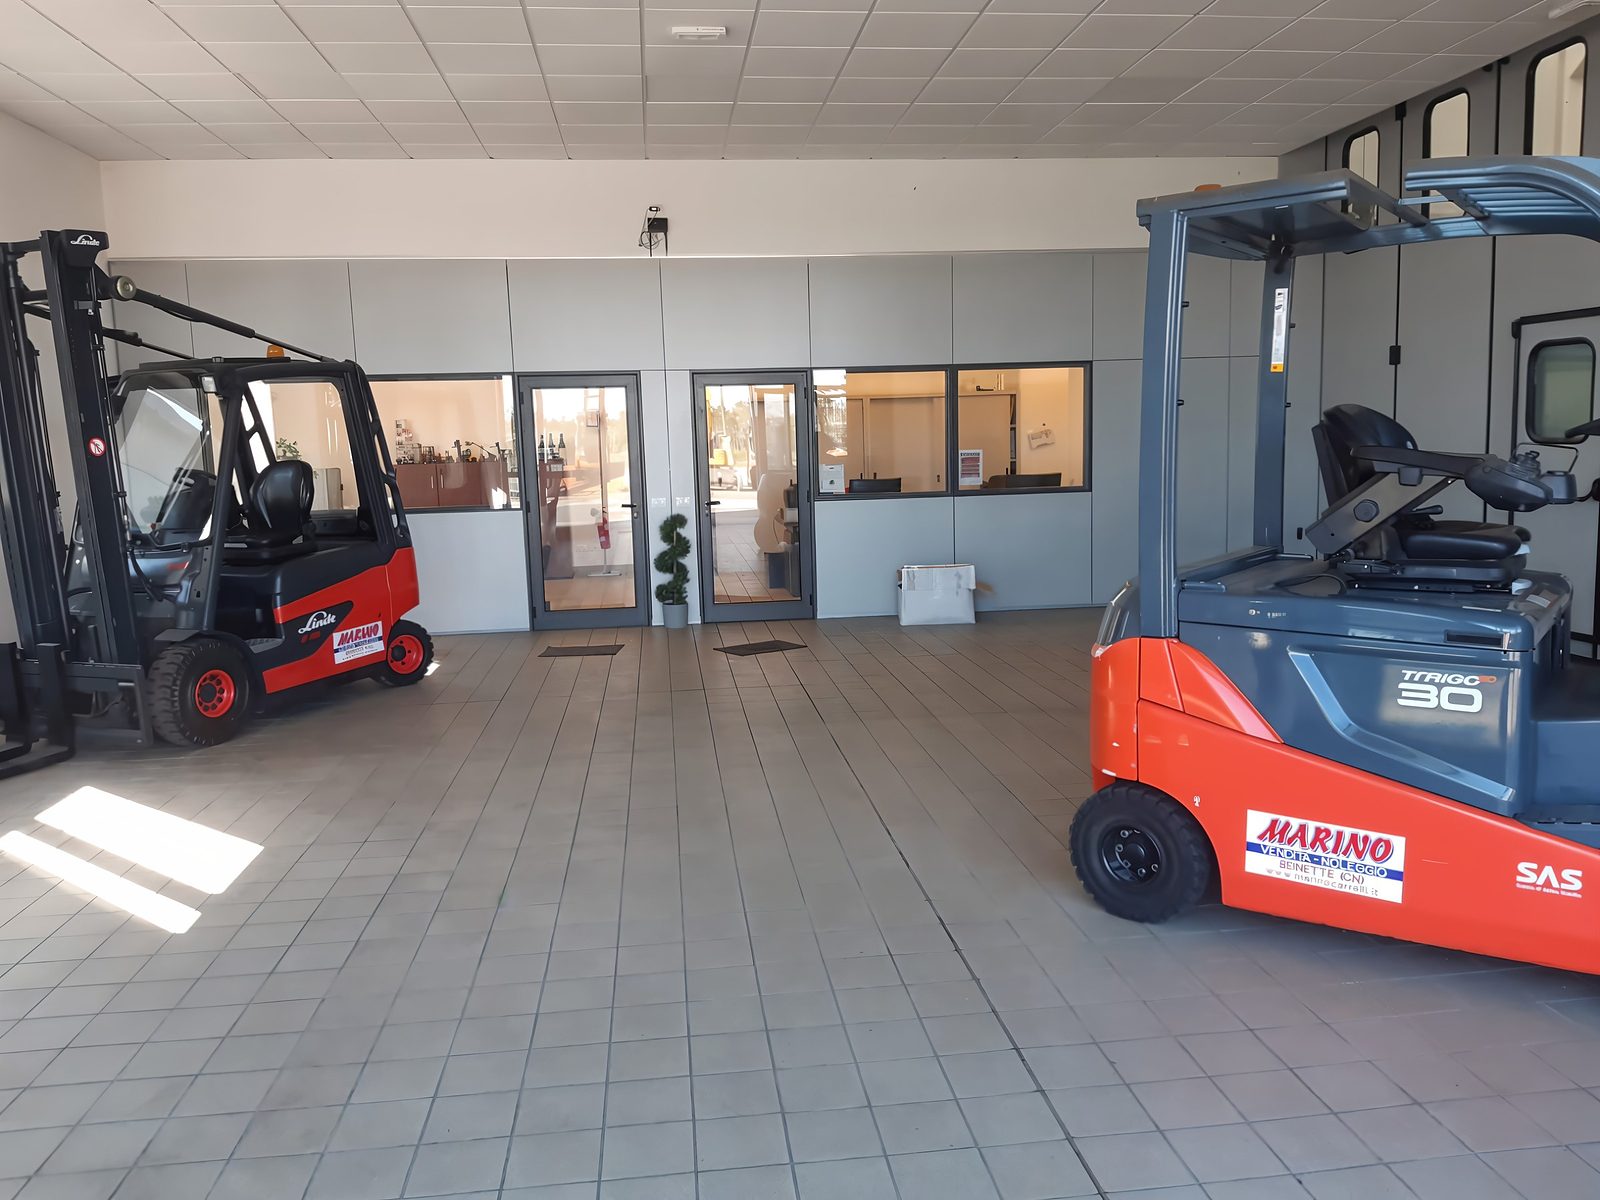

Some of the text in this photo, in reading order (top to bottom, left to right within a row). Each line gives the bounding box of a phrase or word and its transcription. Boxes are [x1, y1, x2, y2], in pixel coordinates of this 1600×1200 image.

[298, 611, 336, 634] Linde
[1397, 682, 1483, 713] 30
[1257, 818, 1393, 863] MARINO
[1340, 872, 1365, 885] (CN)
[1515, 861, 1583, 891] SAS
